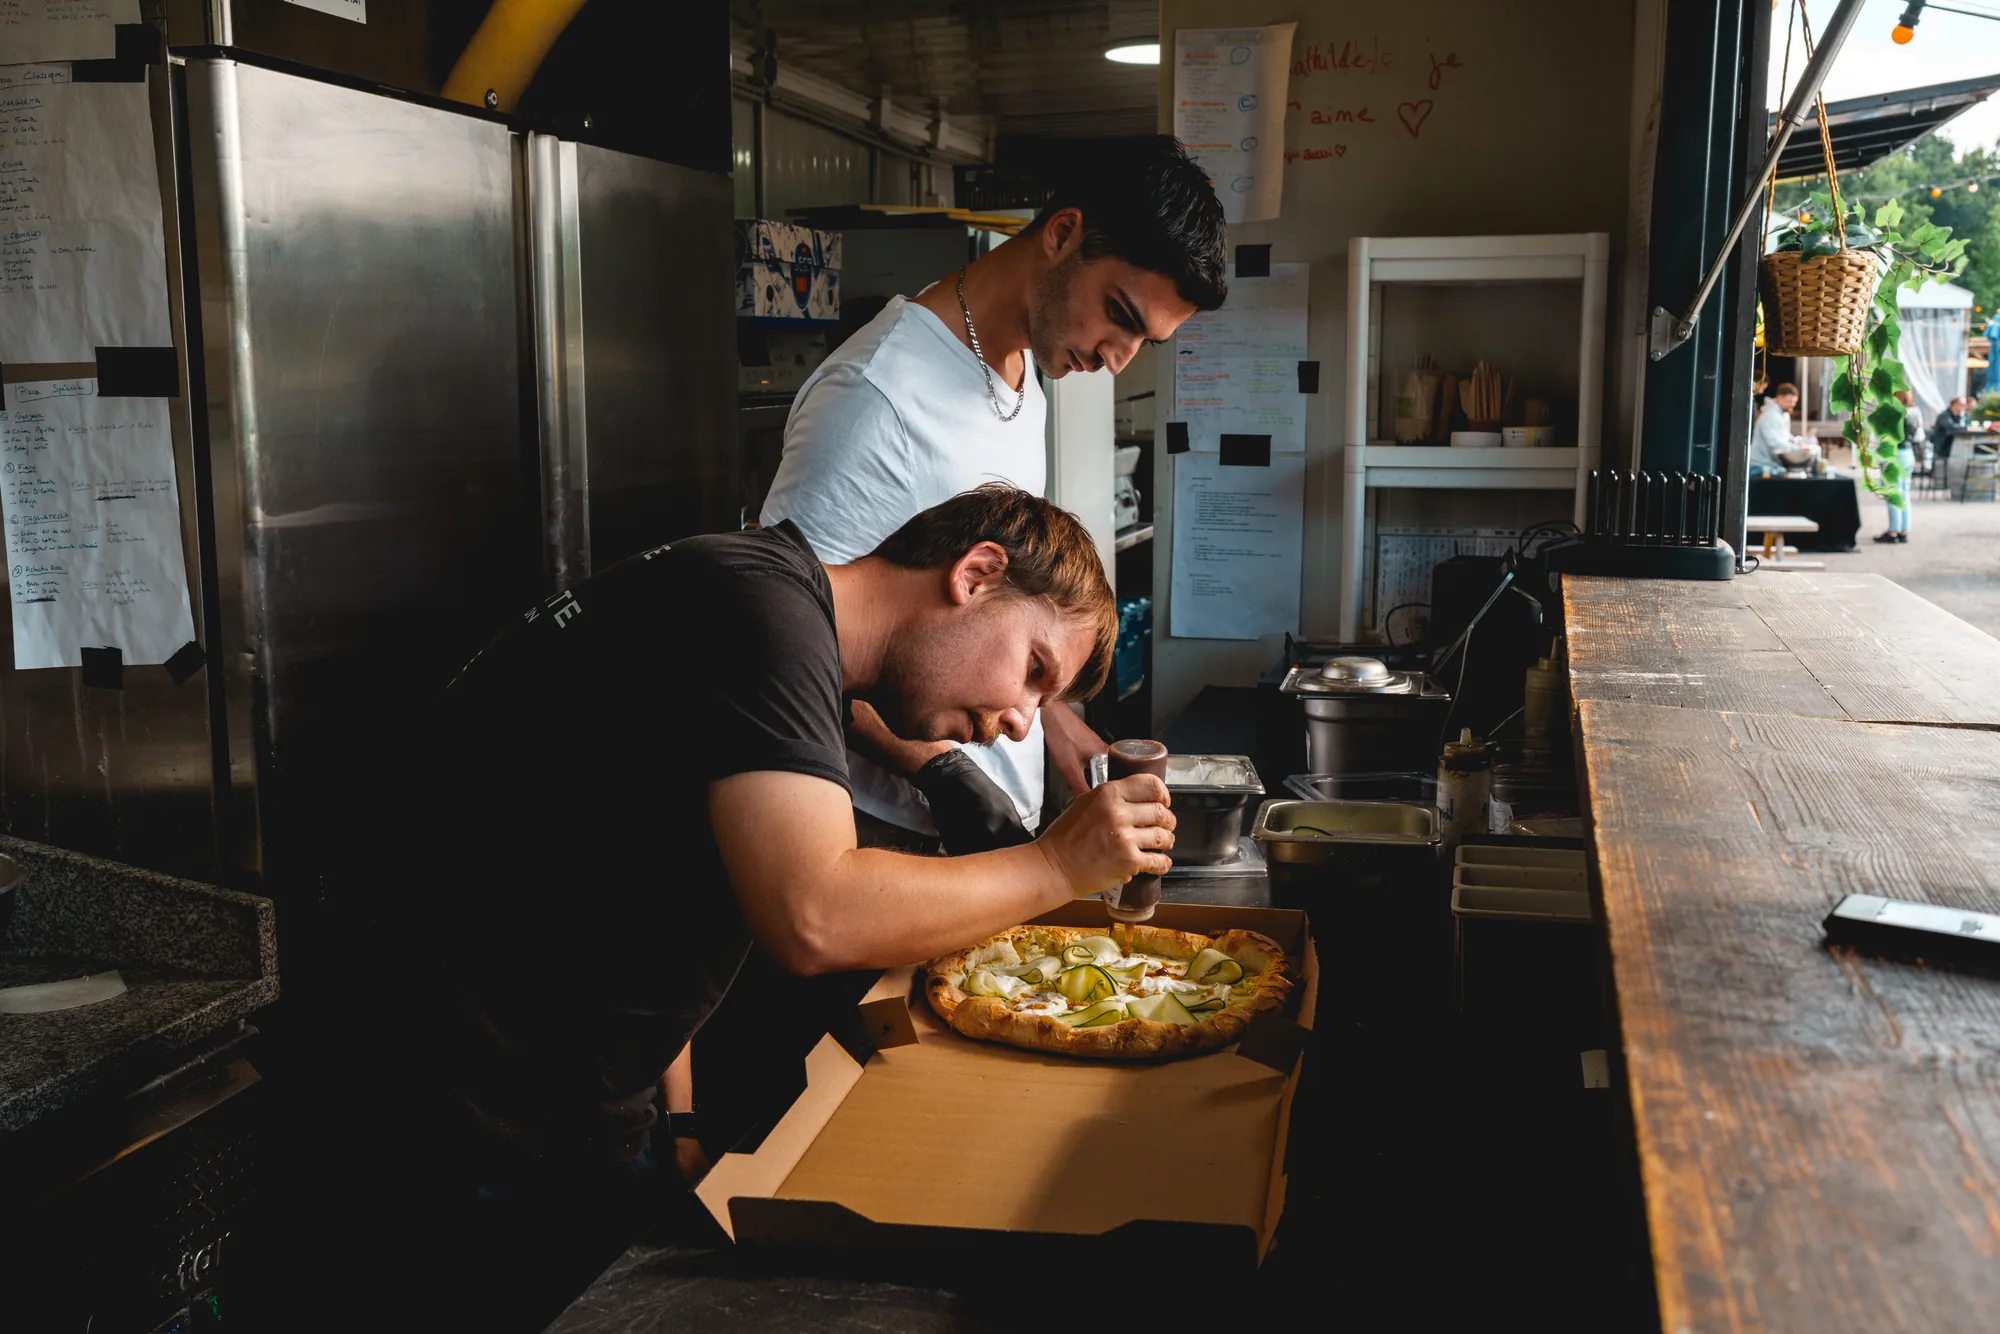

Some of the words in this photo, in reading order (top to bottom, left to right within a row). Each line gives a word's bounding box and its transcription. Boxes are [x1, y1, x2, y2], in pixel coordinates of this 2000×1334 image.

[1427, 37, 1464, 91] je
[23, 70, 65, 84] Classique
[1310, 106, 1375, 126] aime
